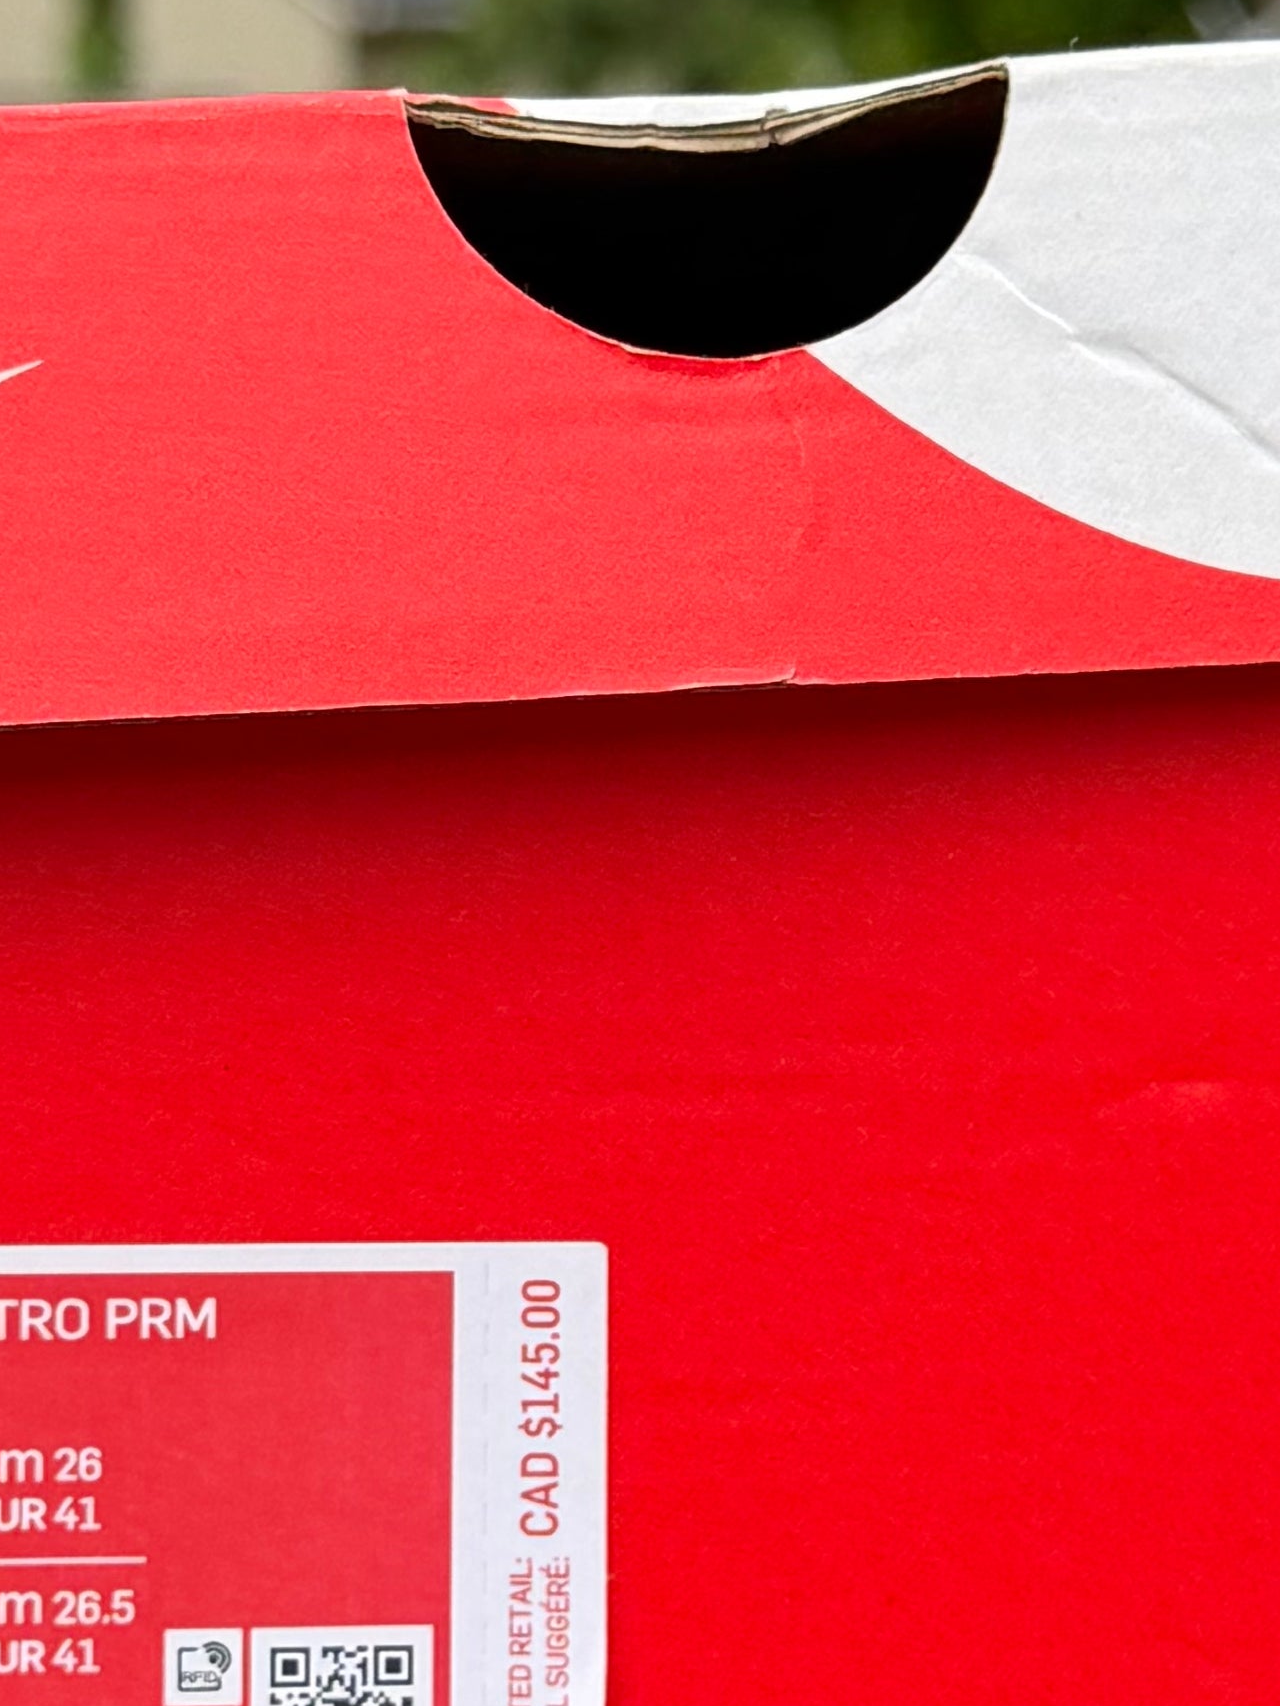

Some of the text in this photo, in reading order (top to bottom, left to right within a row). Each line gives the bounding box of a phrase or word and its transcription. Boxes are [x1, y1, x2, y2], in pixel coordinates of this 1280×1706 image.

[105, 1297, 217, 1340] PRM
[517, 1279, 563, 1537] CAD $145.00
[53, 1446, 103, 1483] 26
[52, 1496, 102, 1532] 41
[51, 1588, 136, 1627] 26.5
[508, 1557, 534, 1657] RETAIL:
[538, 1556, 571, 1688] SUGGÉRÉ:
[51, 1637, 101, 1674] 41
[183, 1669, 218, 1684] RFID
